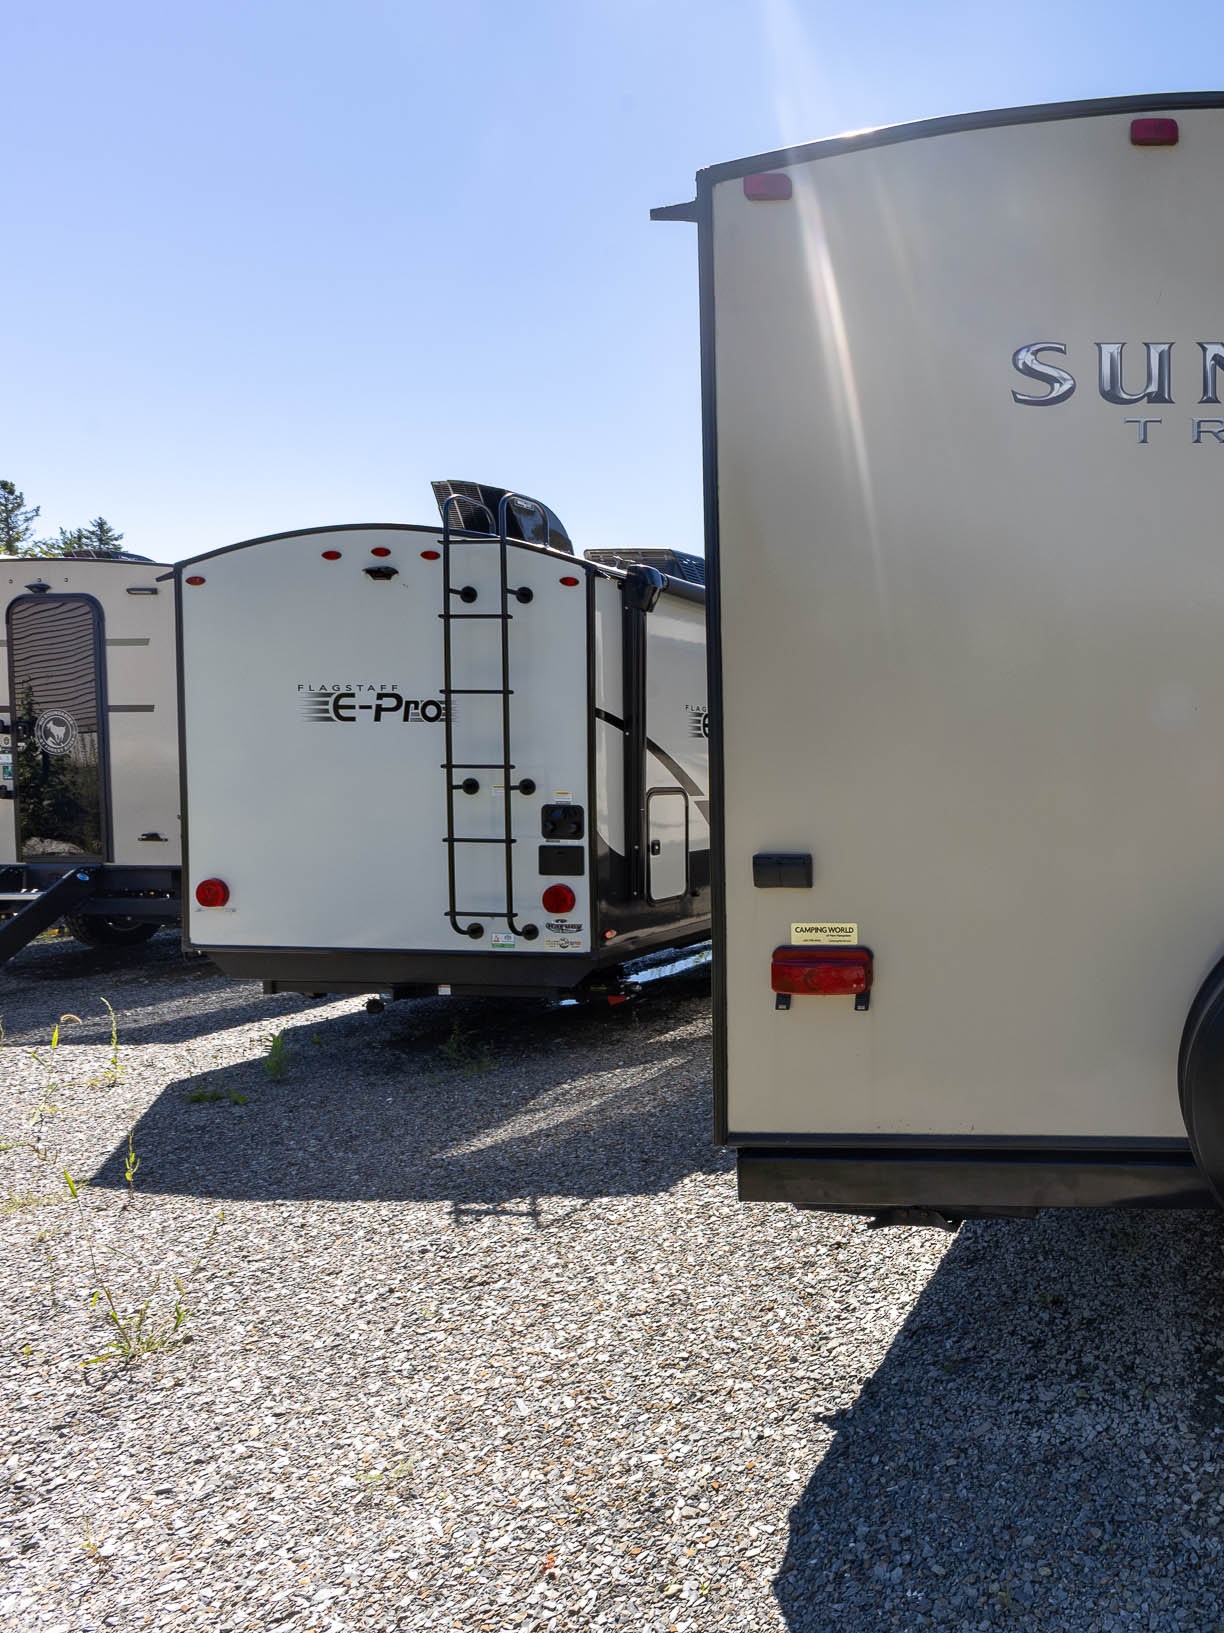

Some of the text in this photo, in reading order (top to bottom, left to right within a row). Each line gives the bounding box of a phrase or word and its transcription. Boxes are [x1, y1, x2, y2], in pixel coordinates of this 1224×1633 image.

[297, 684, 400, 692] FLAGSTAFF
[332, 692, 443, 723] E-Pro
[794, 926, 854, 934] CAMPING WORLD
